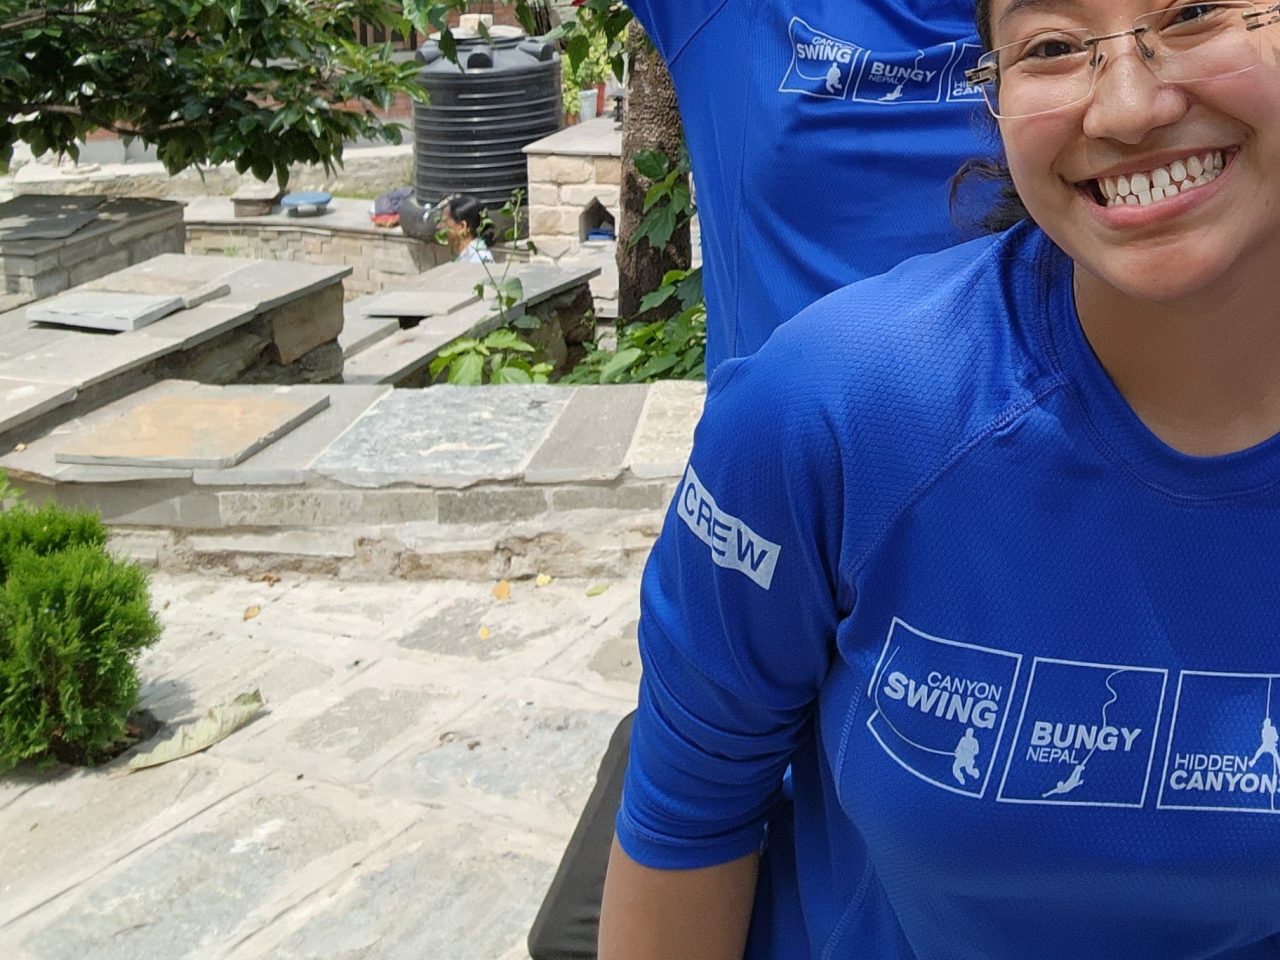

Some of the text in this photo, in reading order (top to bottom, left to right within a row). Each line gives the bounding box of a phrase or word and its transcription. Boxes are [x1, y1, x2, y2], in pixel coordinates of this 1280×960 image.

[796, 43, 852, 64] SWING
[868, 74, 900, 85] NEPAL
[870, 61, 937, 83] BUNGY
[684, 482, 768, 572] CREW
[927, 671, 1002, 701] CANYON
[883, 671, 999, 729] SWING
[1030, 721, 1142, 752] BUNGY
[1026, 746, 1079, 764] NEPAL
[1174, 753, 1248, 772] HIDDEN
